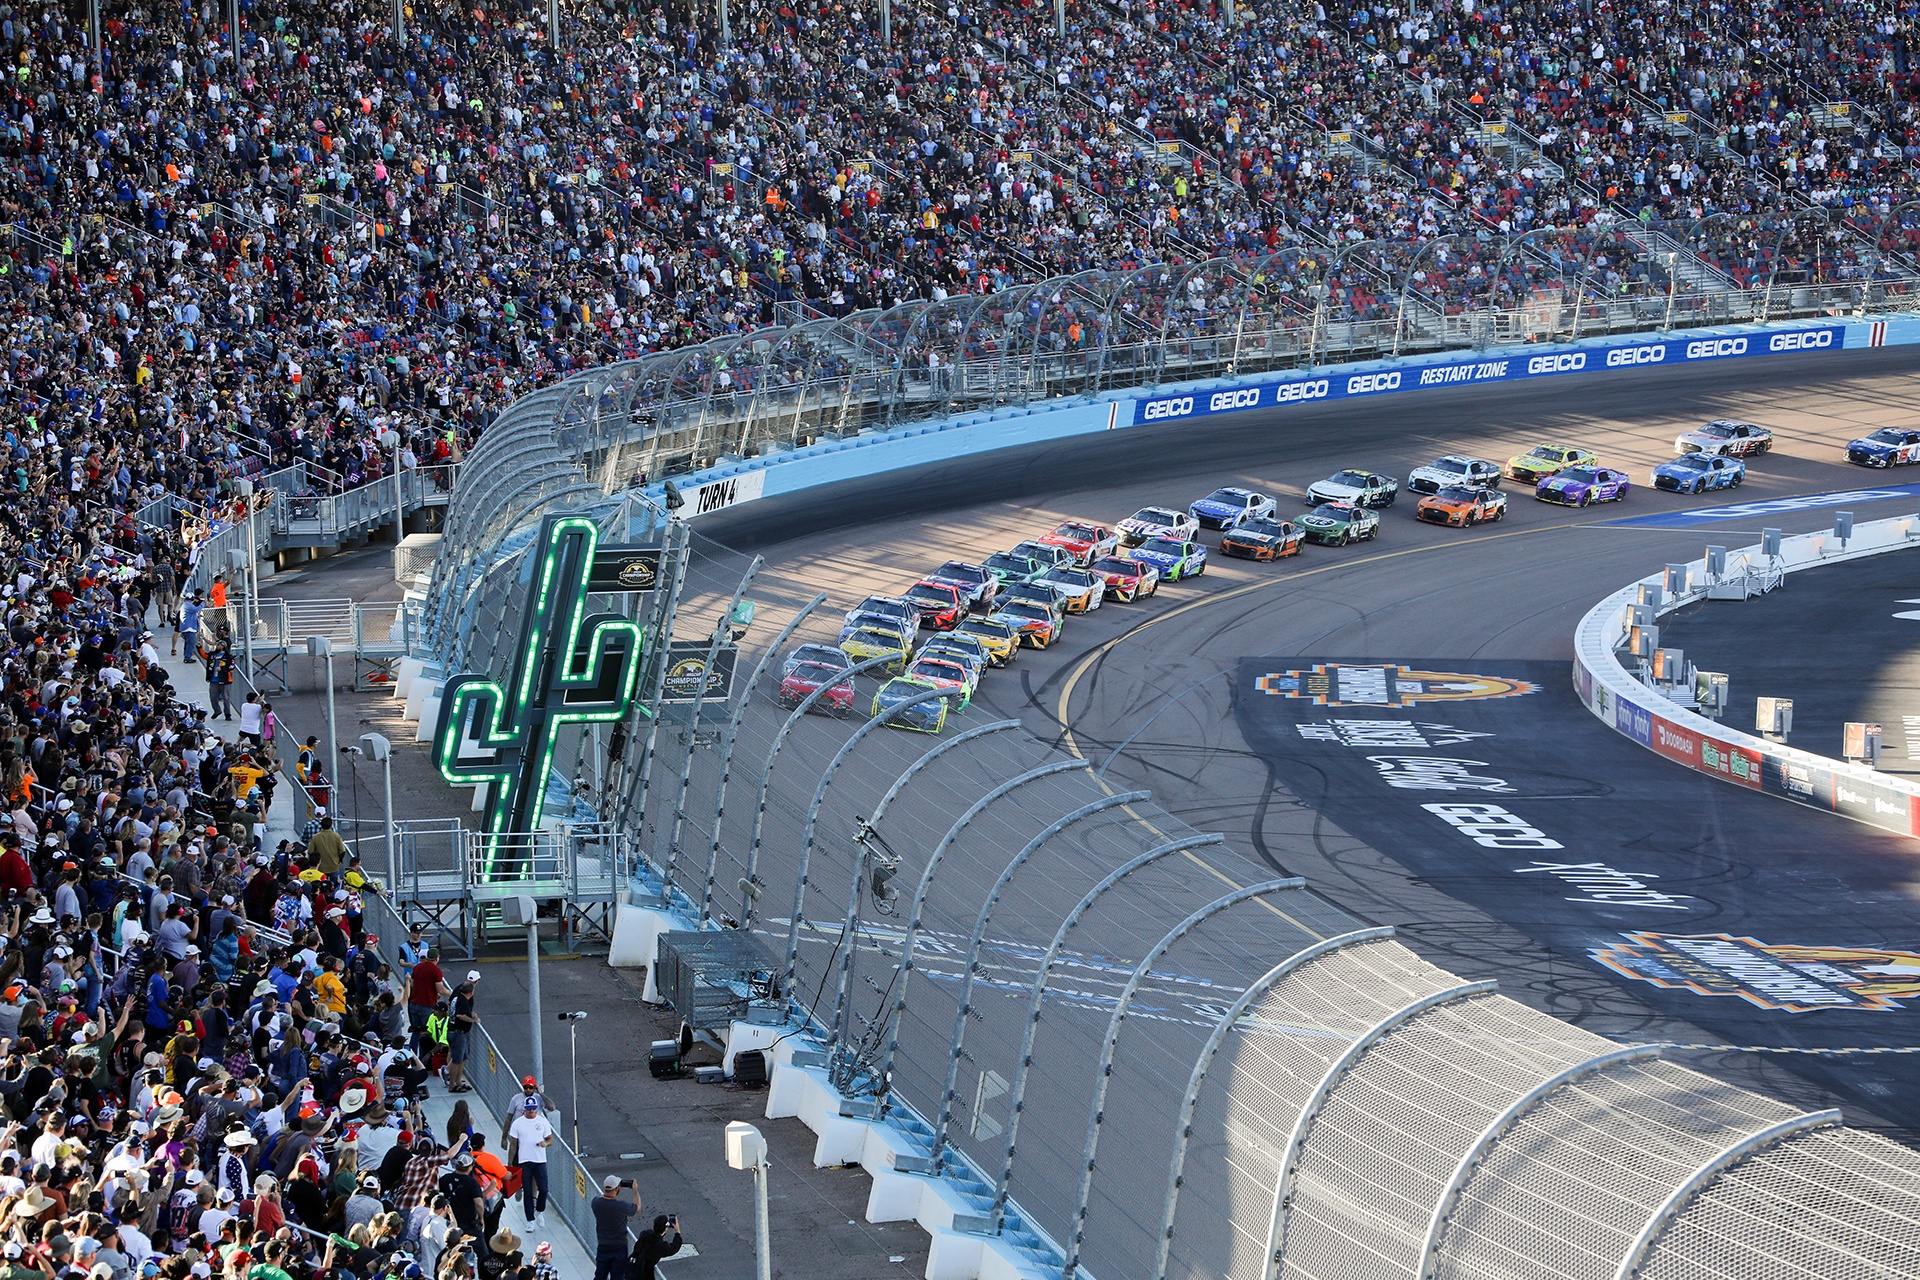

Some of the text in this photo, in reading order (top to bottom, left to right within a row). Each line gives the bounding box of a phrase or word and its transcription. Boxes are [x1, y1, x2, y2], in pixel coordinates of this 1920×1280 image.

[1686, 337, 1748, 359] GEICO
[1769, 330, 1832, 351] GEICO
[1528, 352, 1586, 374] GEICO
[1607, 345, 1665, 367] GEICO
[1347, 371, 1401, 394] GEICO
[1420, 361, 1509, 385] RESTART ZONE
[1210, 389, 1260, 411] GEICO
[1276, 380, 1329, 402] GEICO
[1144, 397, 1193, 420] GEICO
[696, 478, 737, 514] TURN 4
[1682, 491, 1910, 517] GEICO
[1326, 718, 1432, 748] BUSCH
[1634, 709, 1651, 742] xfinity
[1420, 803, 1565, 849] GEICO
[1512, 860, 1695, 910] xfinity
[1663, 938, 1855, 1004] CHAMPIONSHIP
